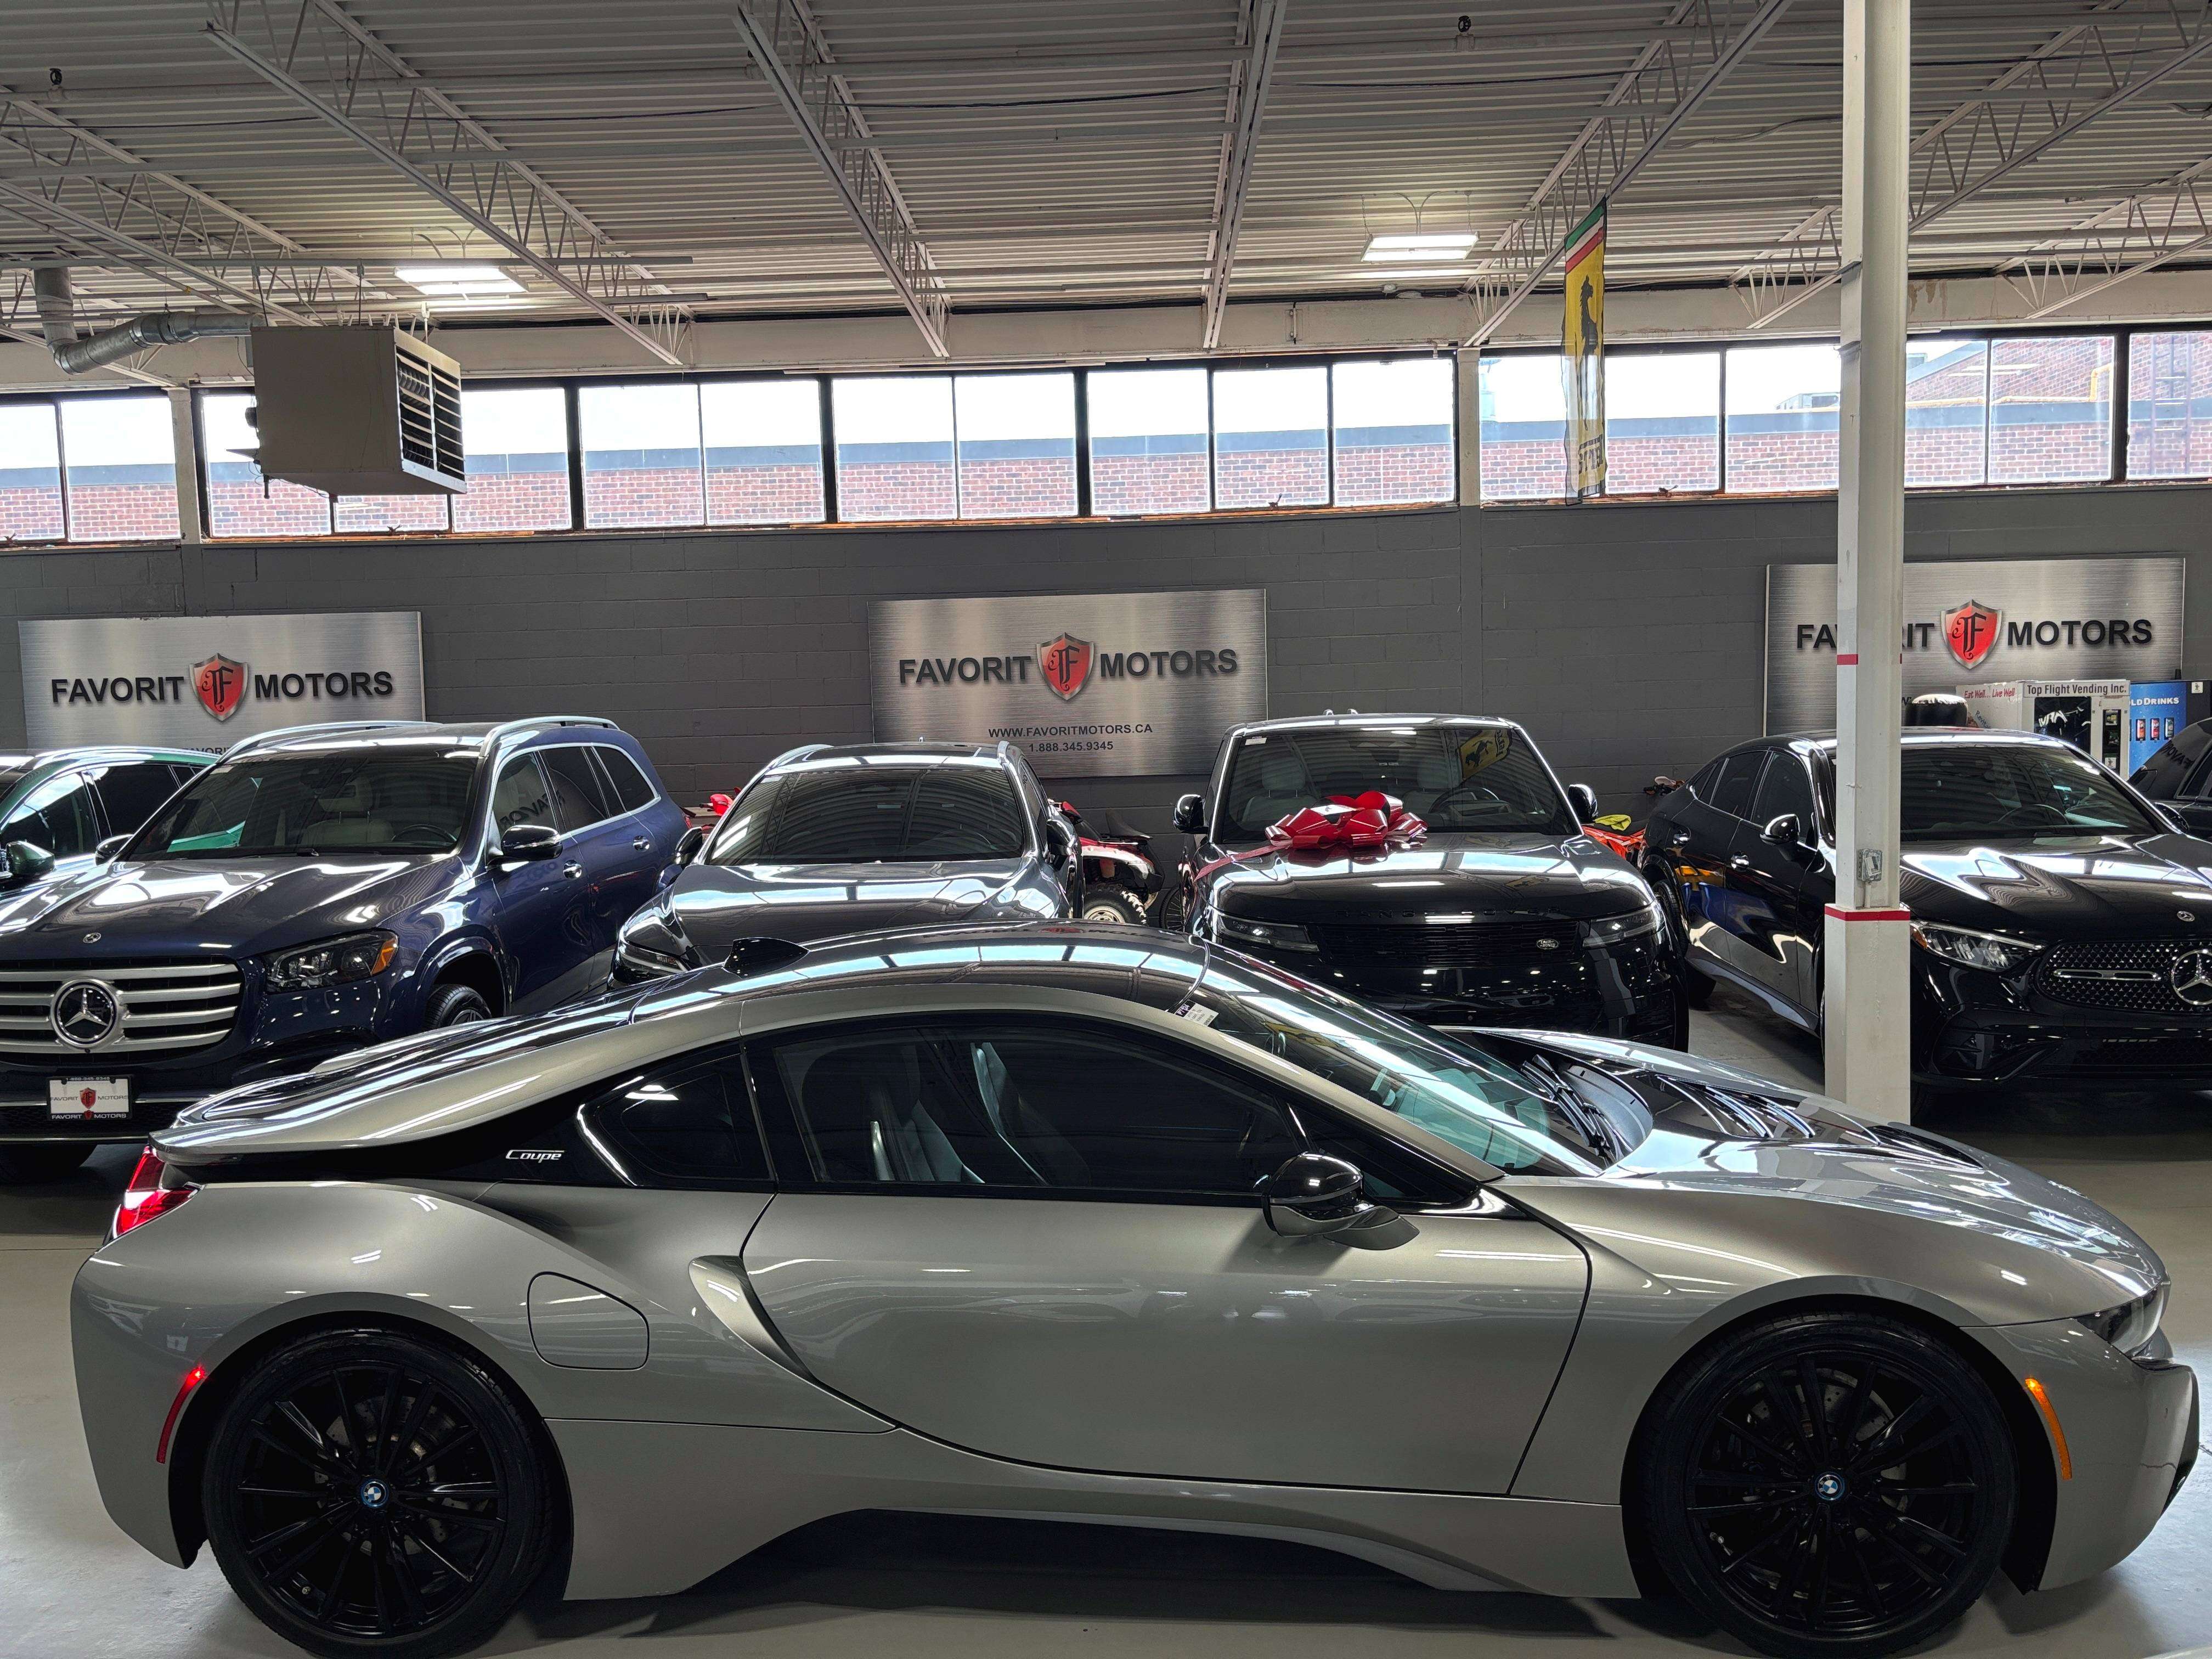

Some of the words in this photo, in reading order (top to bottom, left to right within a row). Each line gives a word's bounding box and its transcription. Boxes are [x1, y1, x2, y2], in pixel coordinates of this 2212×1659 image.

[1797, 623, 1934, 648] FAIT
[2008, 619, 2152, 646] MOTORS
[899, 656, 1031, 684] FAVORIT
[1101, 650, 1237, 676] MOTORS
[52, 677, 184, 703] FAVORIT
[255, 672, 393, 697] MOTORS
[1964, 690, 1974, 698] Eat
[1992, 689, 2002, 697] Live
[2004, 687, 2016, 697] Well
[2027, 685, 2042, 696] Top
[2045, 684, 2070, 695] Flight
[2073, 684, 2108, 695] Vending
[2111, 684, 2127, 693] Inc.
[989, 724, 1153, 738] WWW.FAVORITMOTORS.CA
[1029, 741, 1114, 752] 1.888.345.9345
[505, 1149, 565, 1164] Coupe
